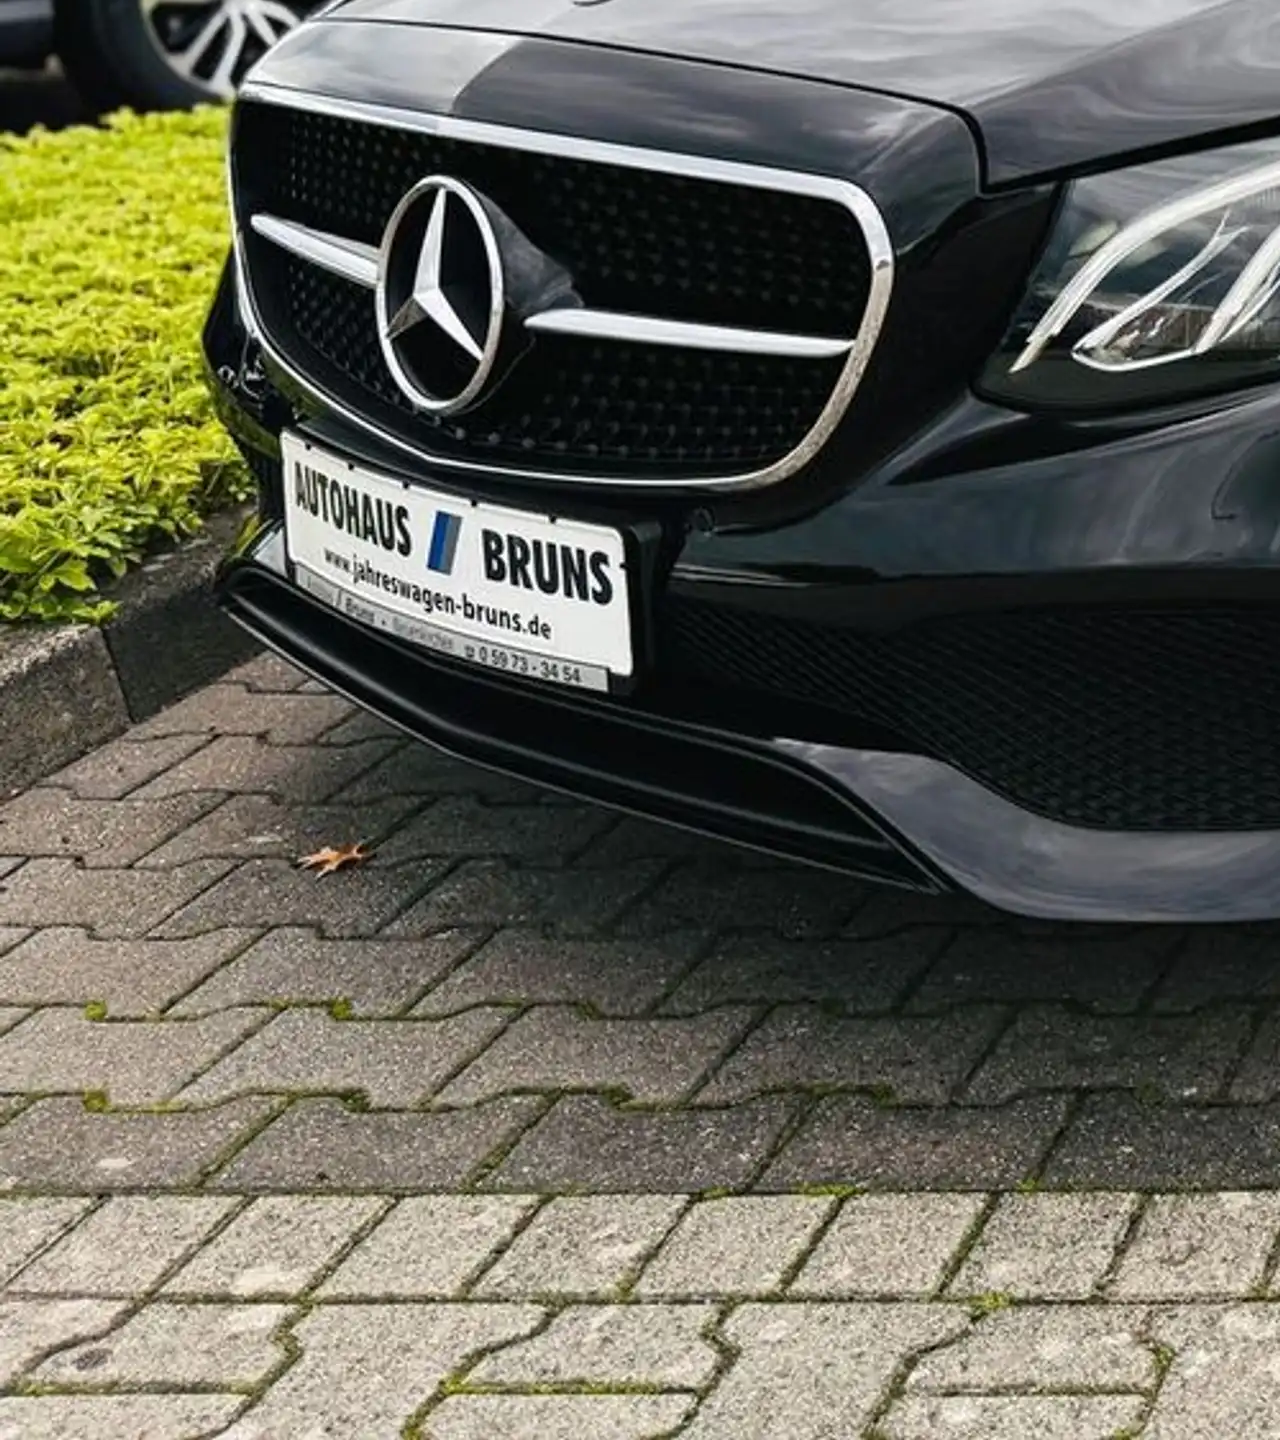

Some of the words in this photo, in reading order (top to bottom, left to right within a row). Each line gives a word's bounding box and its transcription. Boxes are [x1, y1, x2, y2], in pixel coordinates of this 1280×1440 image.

[295, 461, 412, 558] AUTOHAUS
[482, 528, 613, 606] BRUNS
[324, 548, 552, 640] www.jahreswagen-bruns.de
